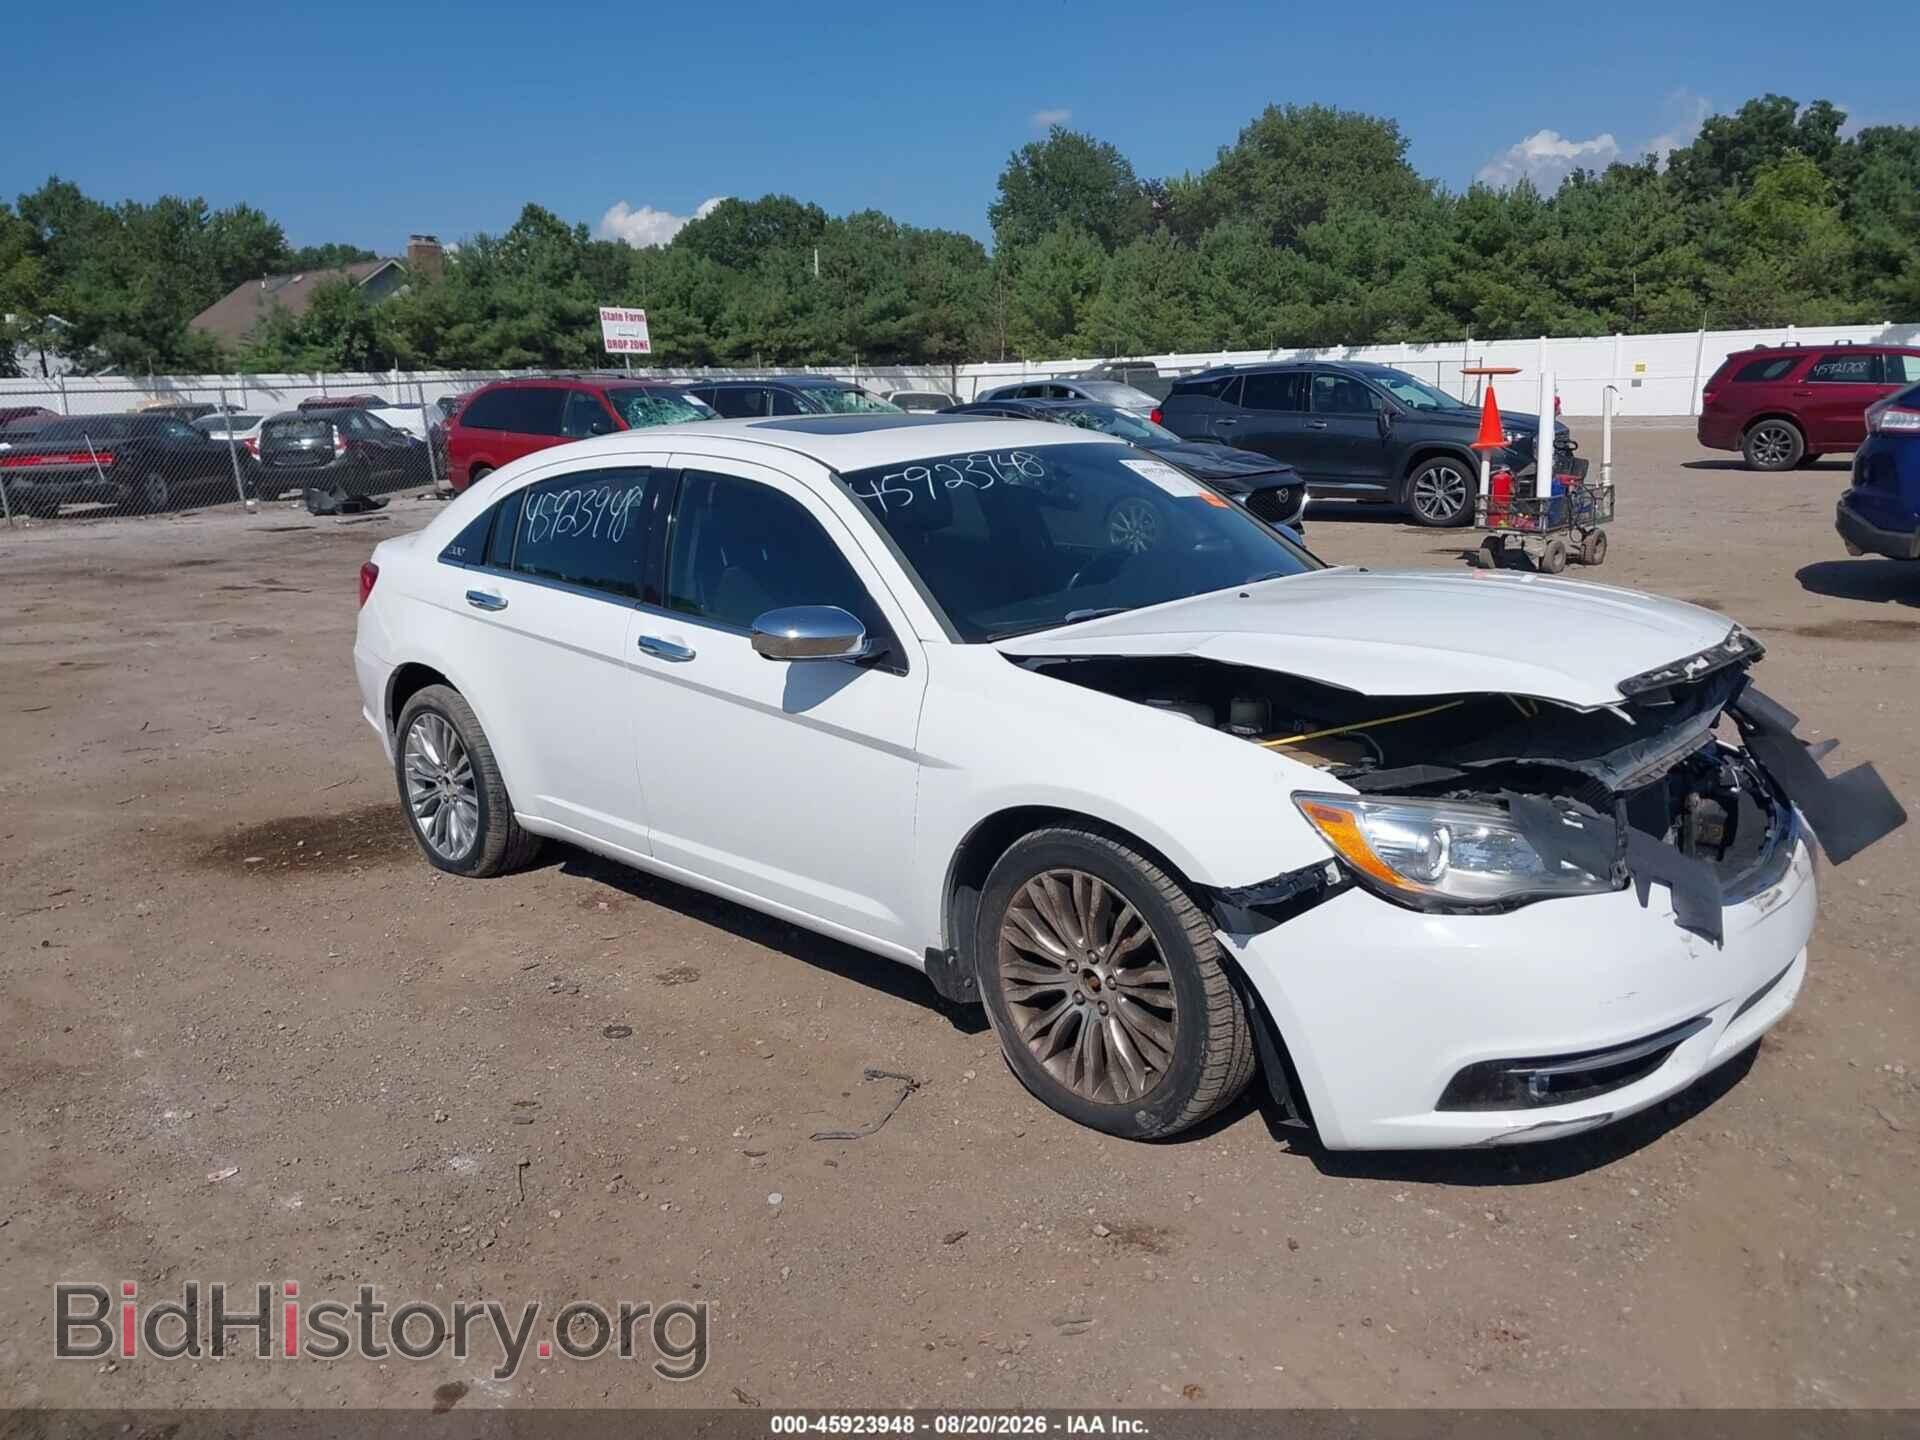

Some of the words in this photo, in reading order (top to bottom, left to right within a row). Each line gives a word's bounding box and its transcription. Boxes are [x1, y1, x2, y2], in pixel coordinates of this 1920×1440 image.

[602, 311, 624, 321] State
[625, 312, 645, 322] Farm
[607, 340, 628, 349] DROP
[630, 340, 649, 350] ZONE
[849, 451, 1044, 512] 45923948
[526, 485, 643, 543] 45923948
